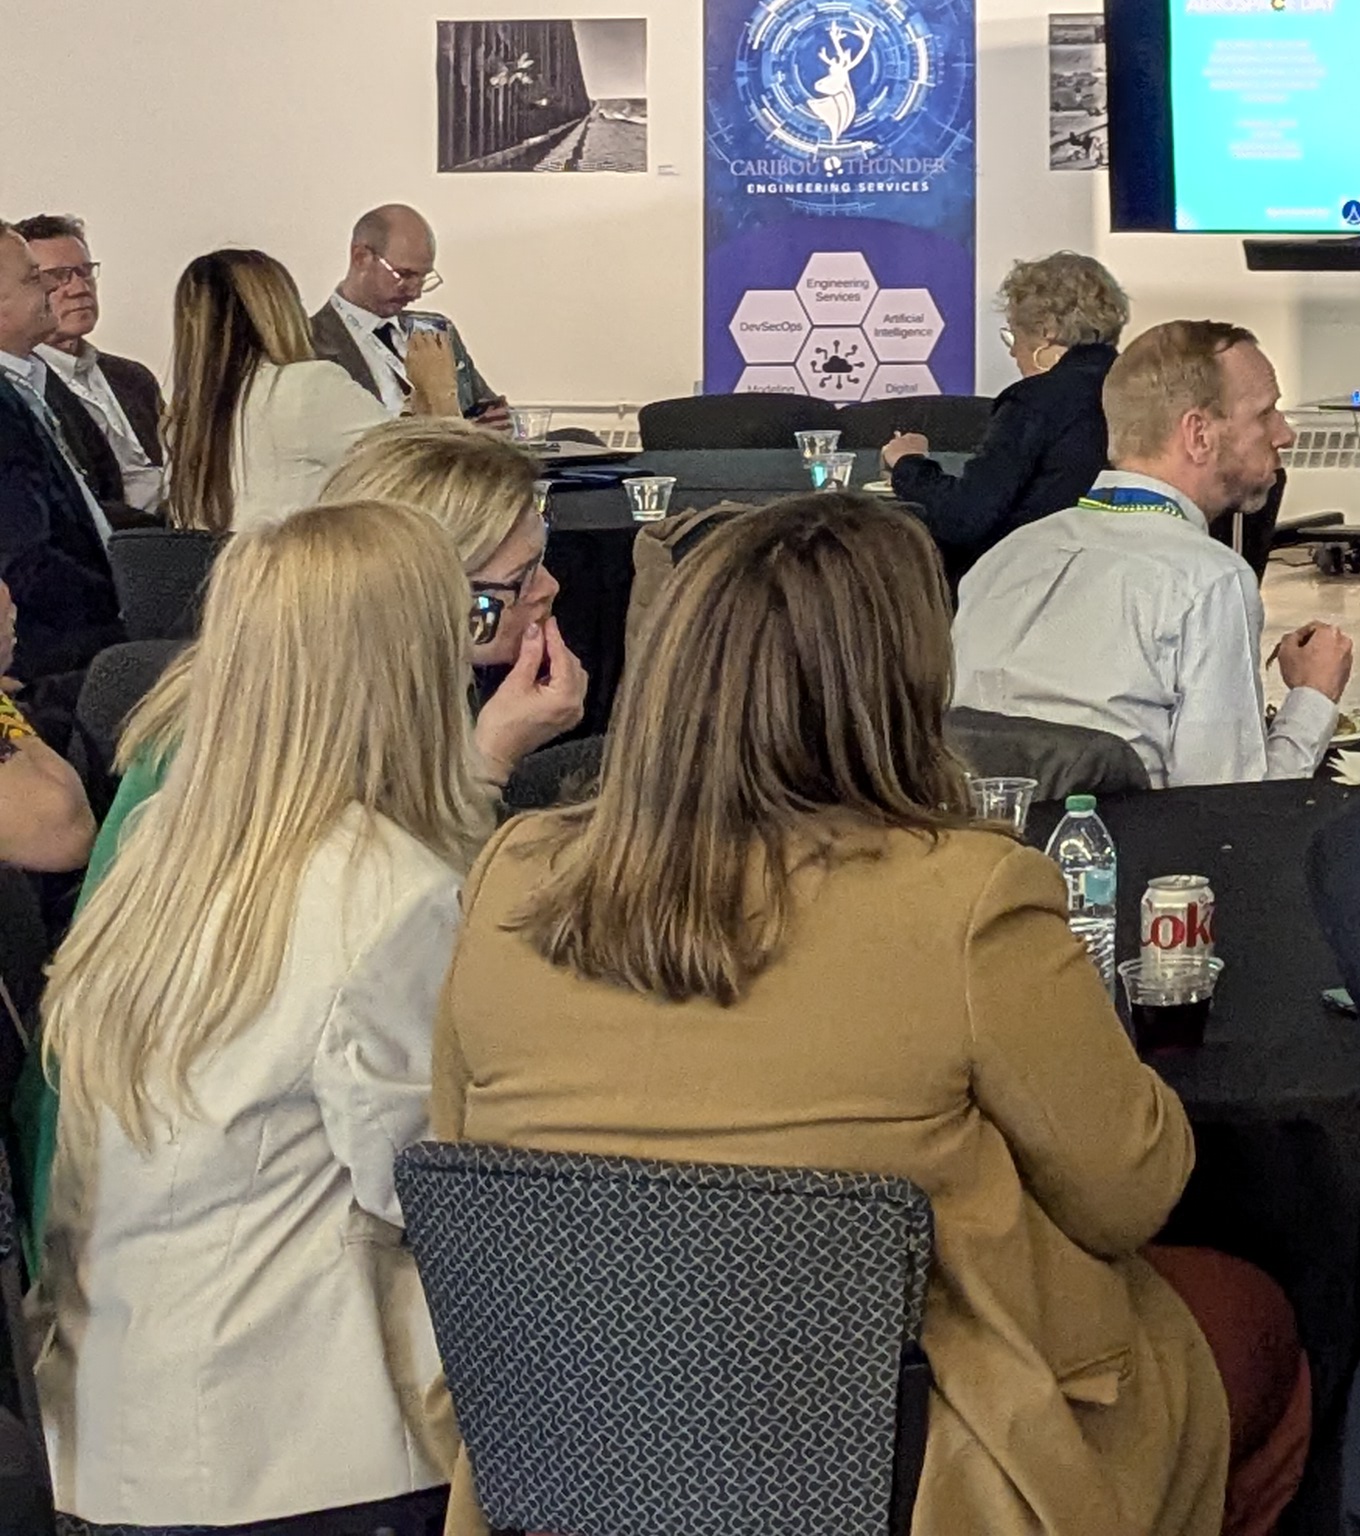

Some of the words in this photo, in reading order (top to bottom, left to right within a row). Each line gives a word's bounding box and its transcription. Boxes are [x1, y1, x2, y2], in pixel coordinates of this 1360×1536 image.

[730, 159, 819, 176] CARIBOU
[847, 157, 949, 175] THUNDER
[747, 183, 851, 194] ENGINEERING
[858, 181, 930, 193] SERVICES
[806, 278, 869, 290] Engineering
[815, 292, 861, 302] Services
[882, 314, 925, 324] Artificial
[739, 321, 803, 332] DevSecOps
[874, 327, 934, 339] Intelligence
[885, 383, 918, 394] Digital
